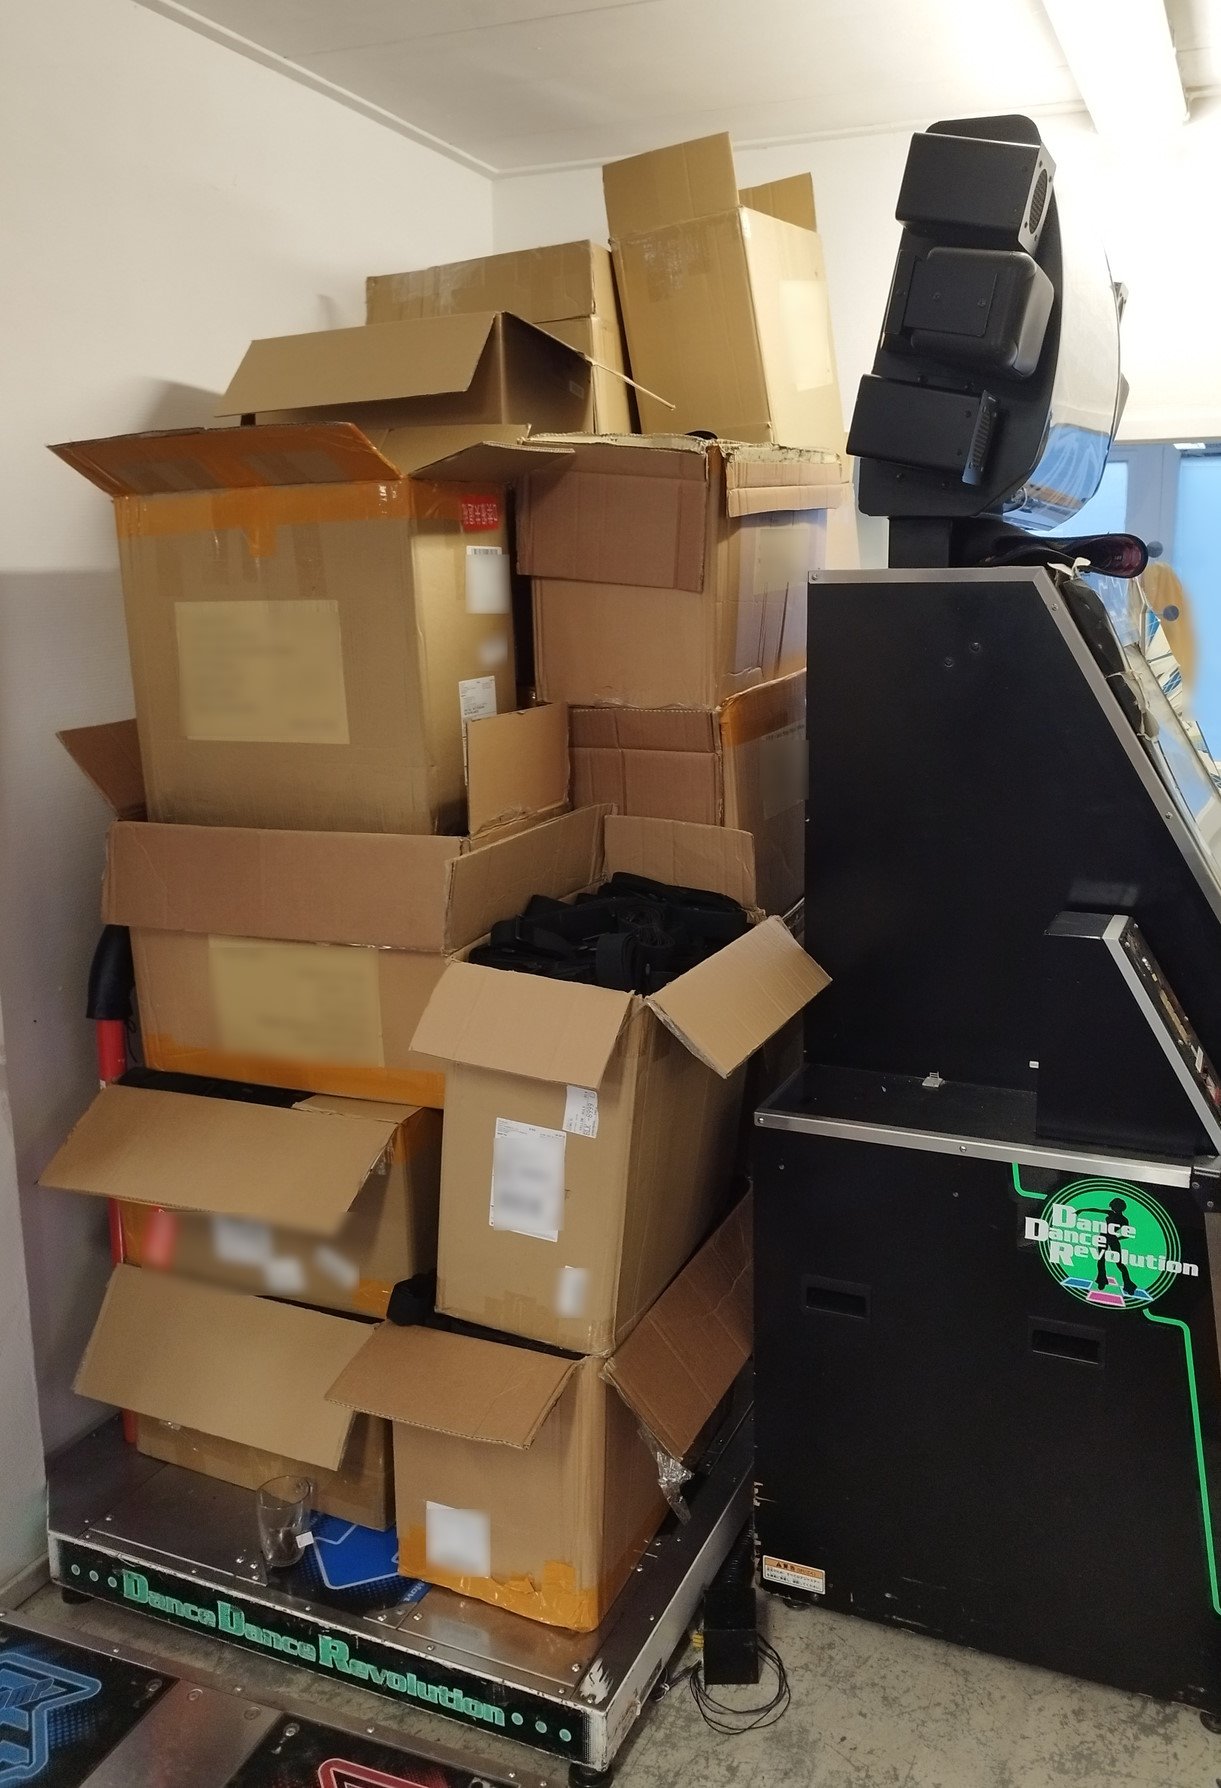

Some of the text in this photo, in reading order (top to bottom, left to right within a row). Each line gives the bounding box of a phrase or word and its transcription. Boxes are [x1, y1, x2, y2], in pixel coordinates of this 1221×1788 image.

[1024, 1216, 1107, 1248] Dance
[1051, 1203, 1137, 1239] Dance
[1050, 1241, 1199, 1277] Revolution
[318, 1634, 506, 1727] Revolution
